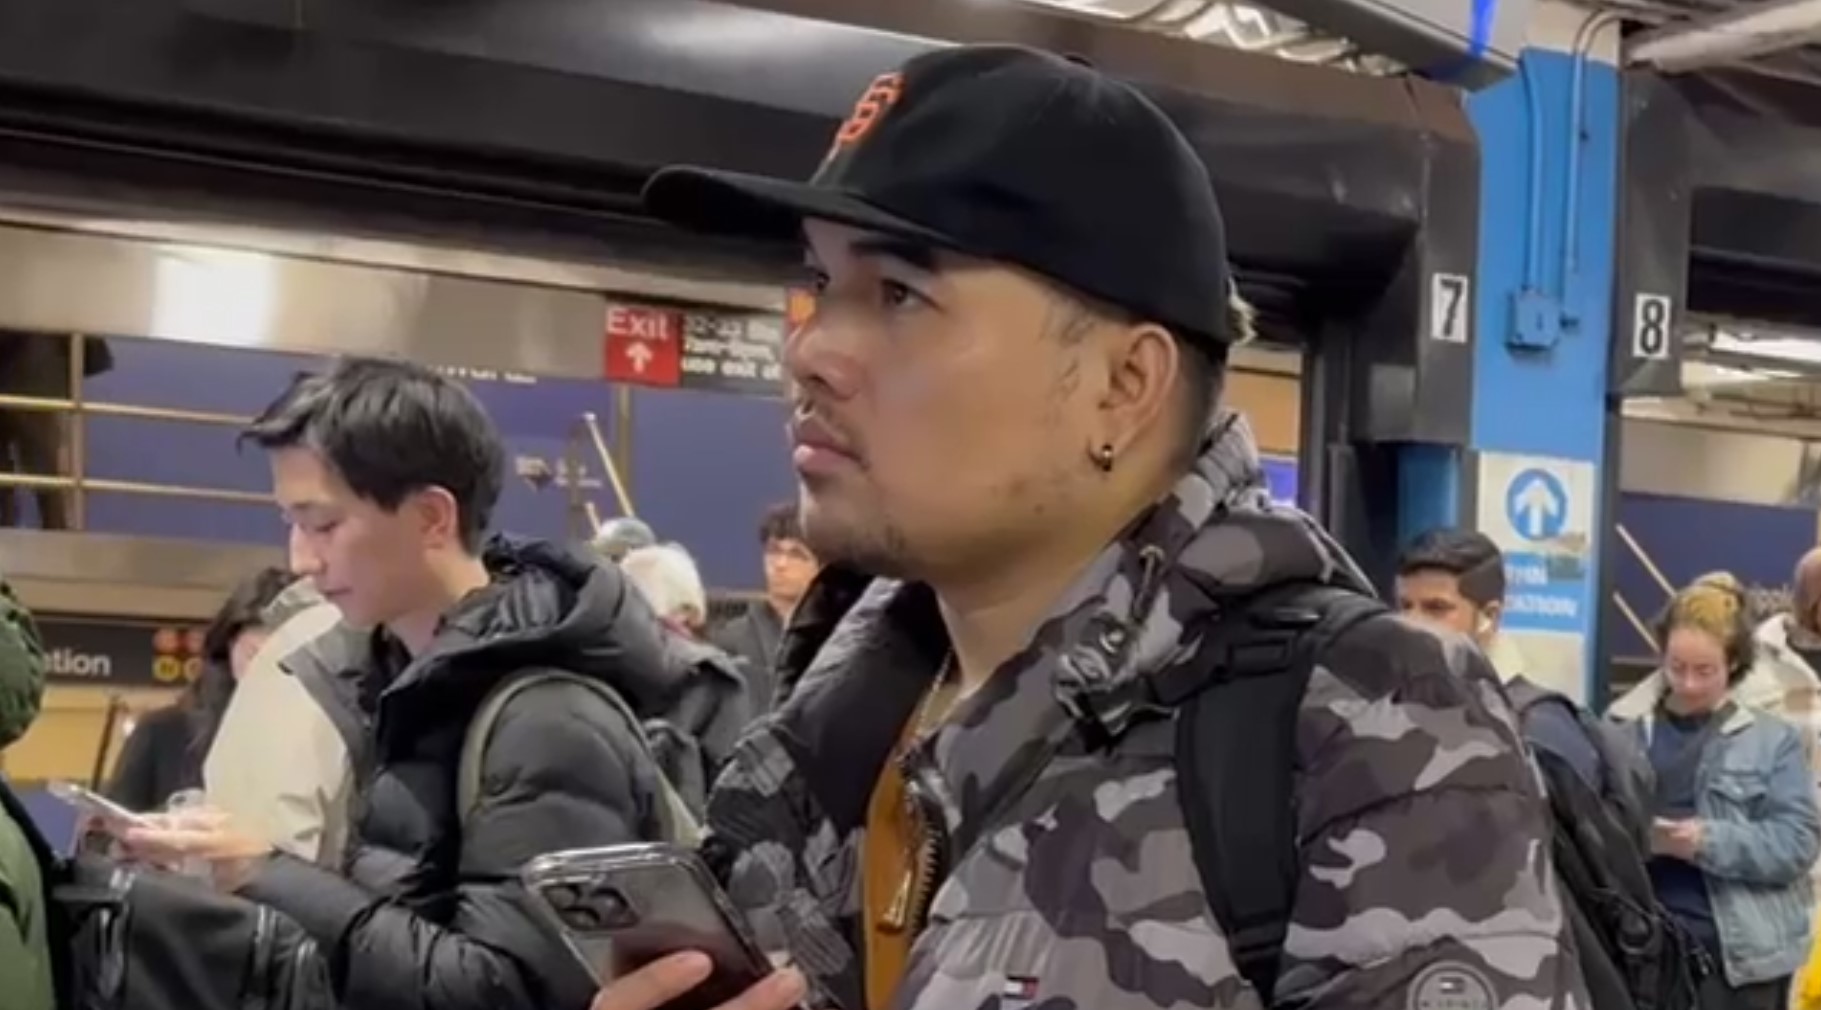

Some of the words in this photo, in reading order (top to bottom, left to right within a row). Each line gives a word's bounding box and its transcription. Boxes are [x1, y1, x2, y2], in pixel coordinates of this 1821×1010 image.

[605, 305, 669, 342] Exit
[1439, 277, 1464, 337] 7
[1638, 298, 1666, 355] 8
